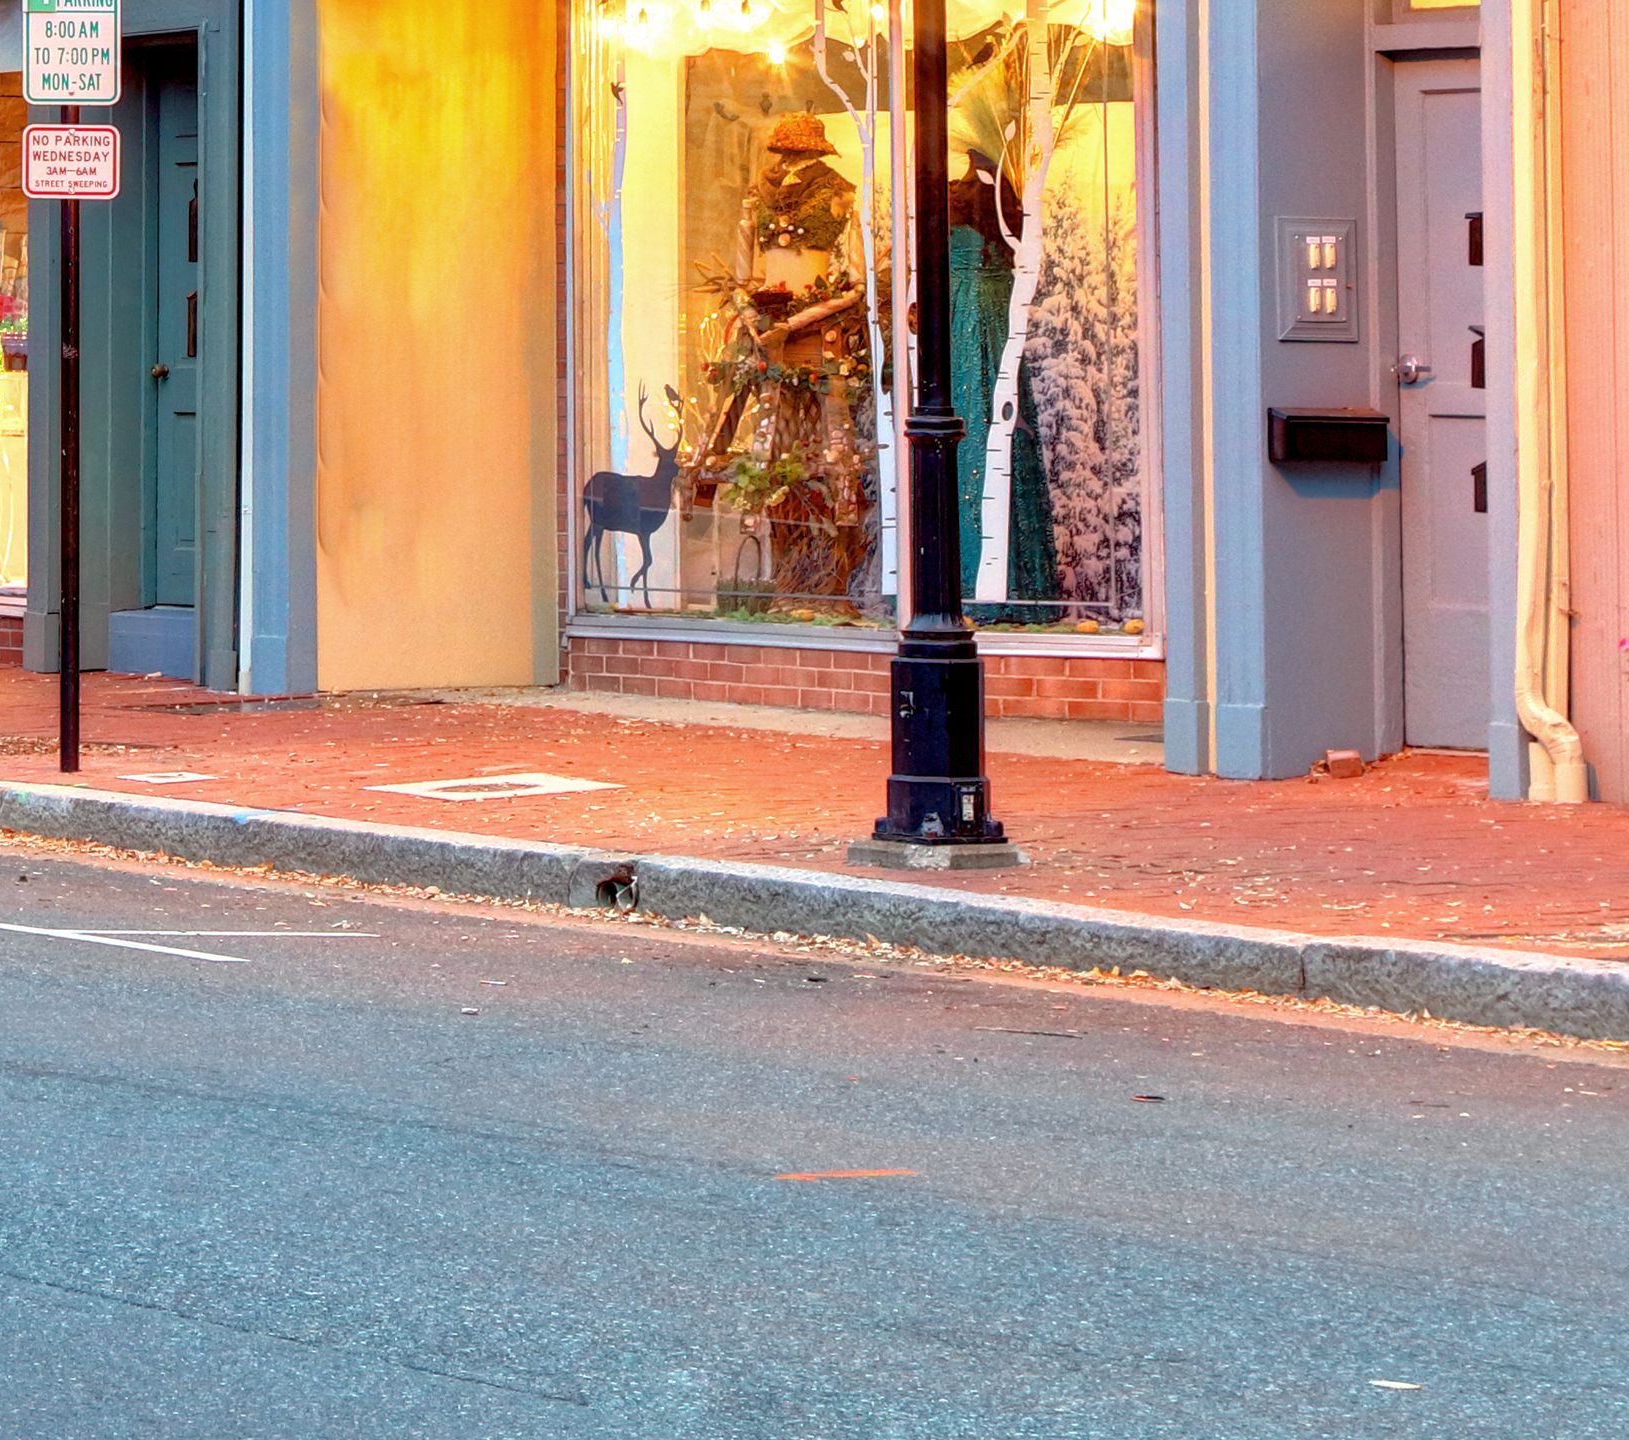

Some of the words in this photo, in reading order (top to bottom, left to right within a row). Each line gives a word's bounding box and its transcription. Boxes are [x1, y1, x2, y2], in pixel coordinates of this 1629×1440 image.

[45, 20, 76, 38] 8:00
[78, 20, 99, 38] AM
[34, 47, 50, 65] TO
[57, 47, 88, 65] 7:00
[91, 47, 110, 65] PM
[32, 135, 49, 146] NO
[54, 135, 111, 147] PARKING
[32, 150, 110, 162] WEDNESDAY
[35, 180, 65, 188] STREET
[67, 180, 108, 189] SWEEPING
